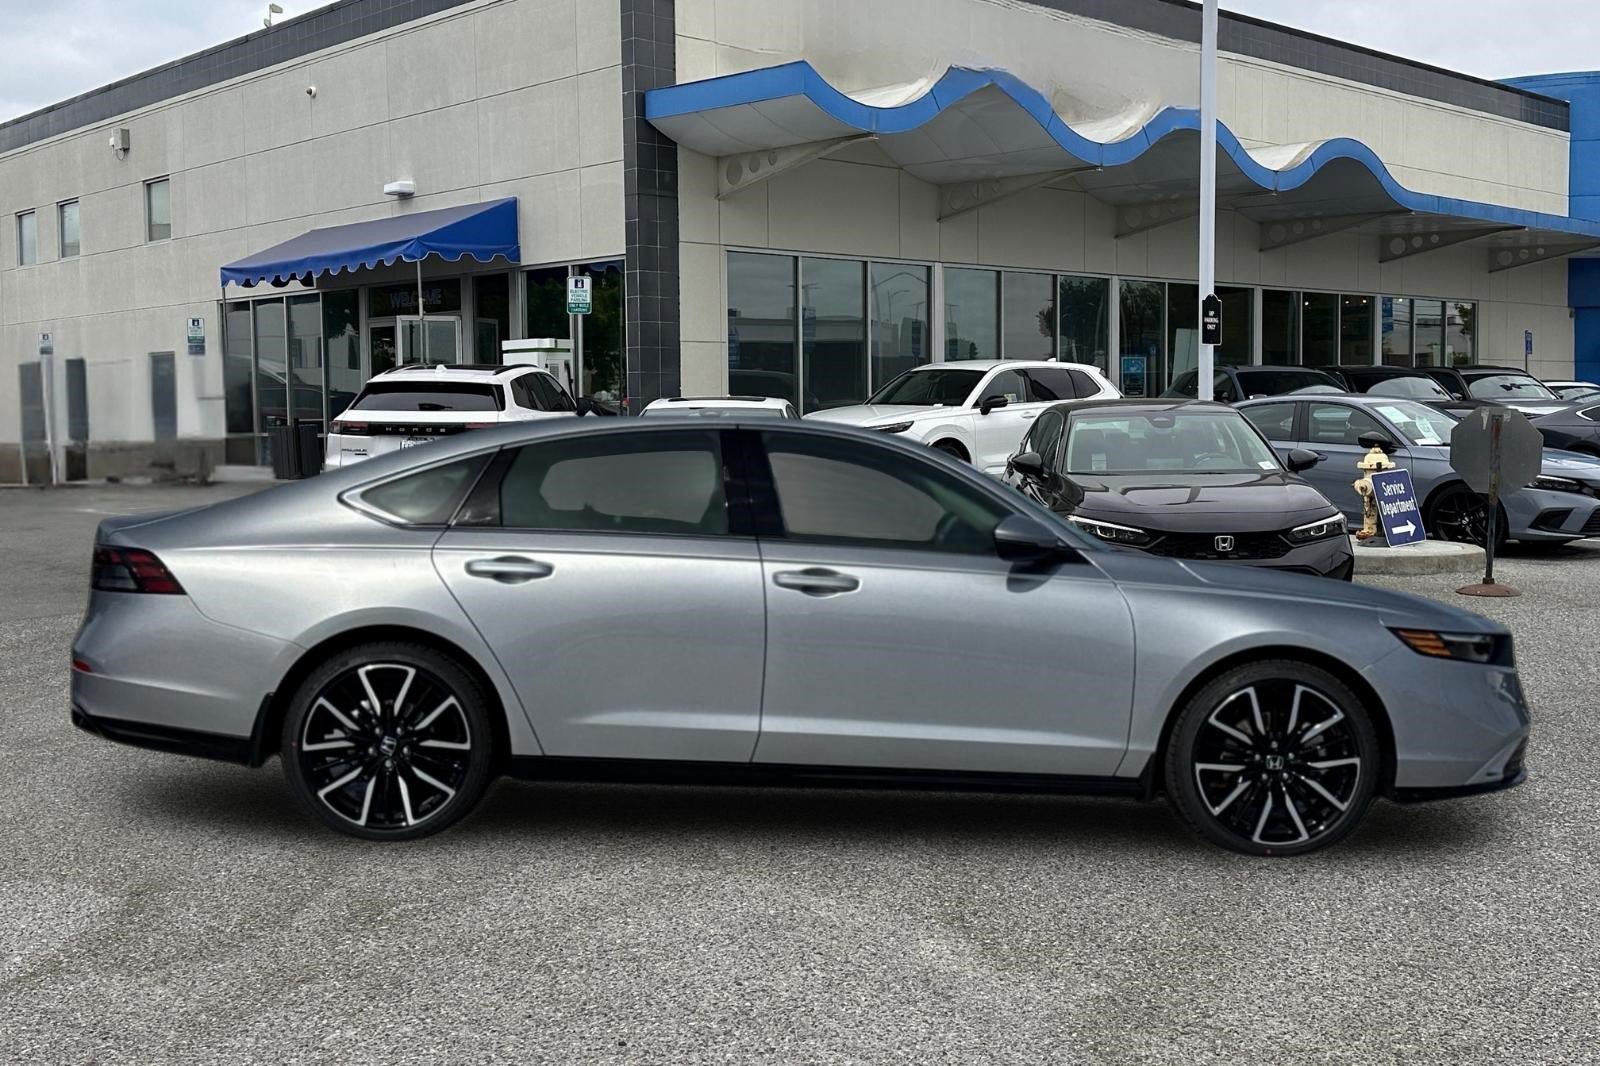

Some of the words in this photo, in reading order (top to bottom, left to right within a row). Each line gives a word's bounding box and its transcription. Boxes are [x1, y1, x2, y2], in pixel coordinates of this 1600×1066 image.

[390, 288, 442, 306] WELCME
[1381, 480, 1406, 496] Service
[1380, 496, 1417, 518] Department
